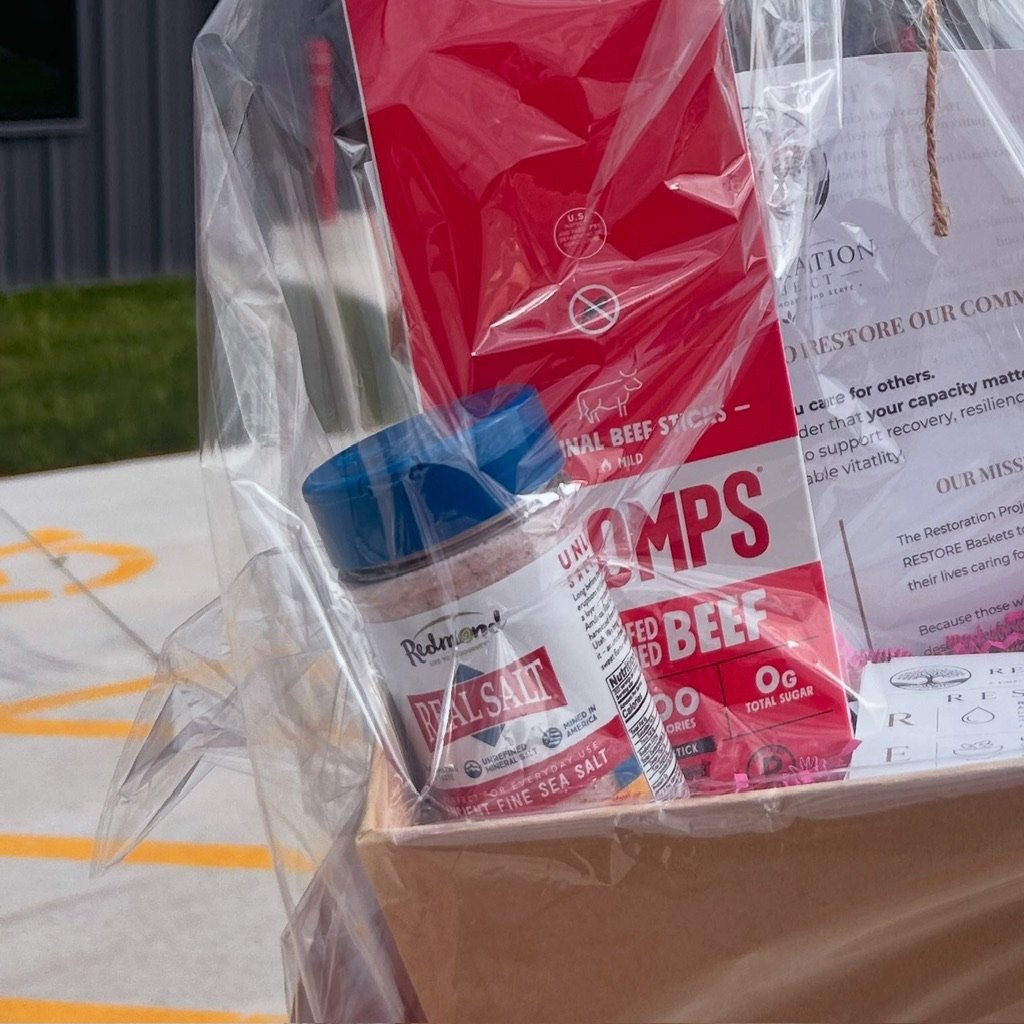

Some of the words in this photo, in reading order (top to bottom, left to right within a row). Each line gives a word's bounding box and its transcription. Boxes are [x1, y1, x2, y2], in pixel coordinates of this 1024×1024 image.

[801, 317, 905, 360] RESTORE
[908, 304, 956, 330] OUR
[795, 403, 804, 416] u
[849, 385, 872, 400] for
[877, 369, 935, 393] others.
[799, 422, 824, 439] der
[828, 411, 863, 431] that
[866, 400, 904, 424] your
[908, 381, 978, 409] capacity
[609, 420, 652, 447] BEEF
[804, 450, 815, 462] o
[818, 429, 882, 457] support
[887, 411, 957, 437] recovery,
[617, 453, 644, 468] MILD
[936, 471, 976, 494] OUR
[896, 532, 922, 547] The
[923, 510, 996, 539] Restoration
[902, 542, 964, 568] RESTORE
[965, 529, 1015, 552] Baskets
[907, 574, 939, 592] their
[940, 566, 969, 583] lives
[971, 554, 1012, 575] caring
[624, 616, 659, 643] FED
[663, 588, 768, 661] BEEF
[918, 612, 972, 637] Because
[974, 601, 1010, 620] those
[400, 609, 507, 667] Redmond
[634, 641, 662, 669] ED
[481, 658, 553, 717] SALT
[653, 686, 700, 721] 00
[744, 696, 777, 713] TOTAL
[779, 685, 815, 704] SUGAR
[563, 711, 587, 730] MINED
[589, 704, 597, 716] IN
[566, 716, 598, 738] AMERICA
[665, 717, 697, 734] ORIES
[888, 711, 915, 728] R
[511, 756, 573, 790] EVERYDAY
[579, 741, 600, 759] USE
[673, 743, 699, 757] TICK
[496, 788, 534, 813] FINE
[538, 777, 570, 798] SEA
[574, 748, 609, 780] SALT
